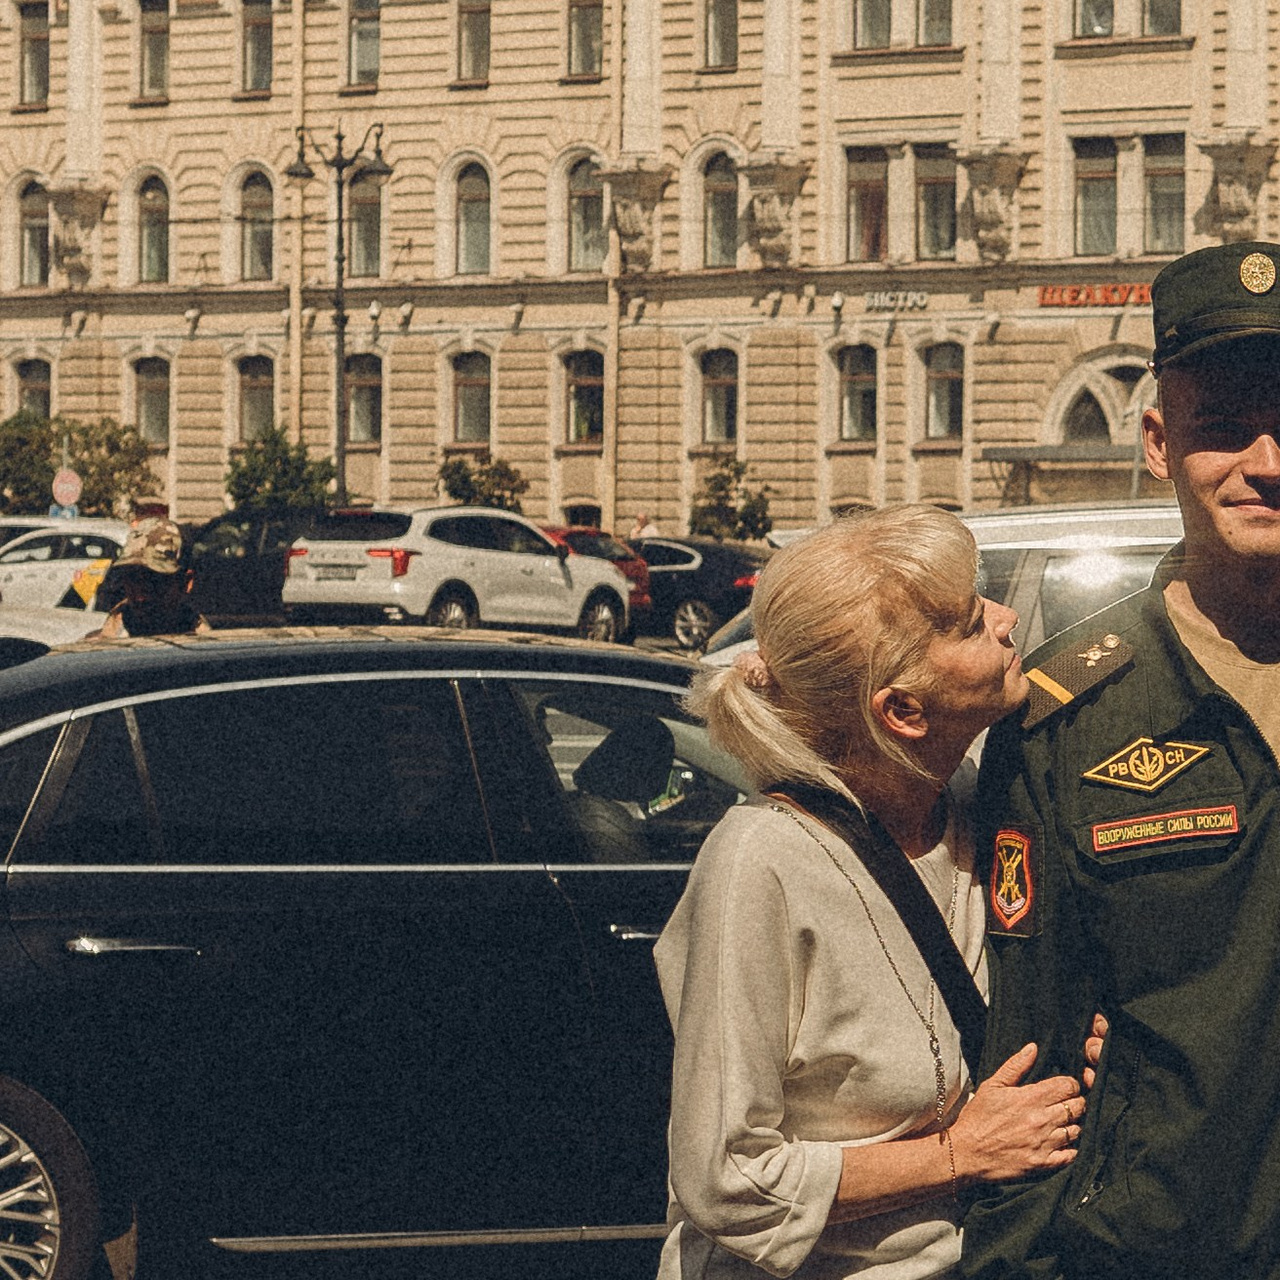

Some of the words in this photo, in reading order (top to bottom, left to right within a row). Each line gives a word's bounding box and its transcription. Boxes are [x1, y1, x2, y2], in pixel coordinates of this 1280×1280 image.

[1096, 821, 1166, 846] ВООРУЖЕННЫЕ
[1167, 816, 1195, 833] СИЛЫ
[1196, 812, 1234, 829] РОССИИ
